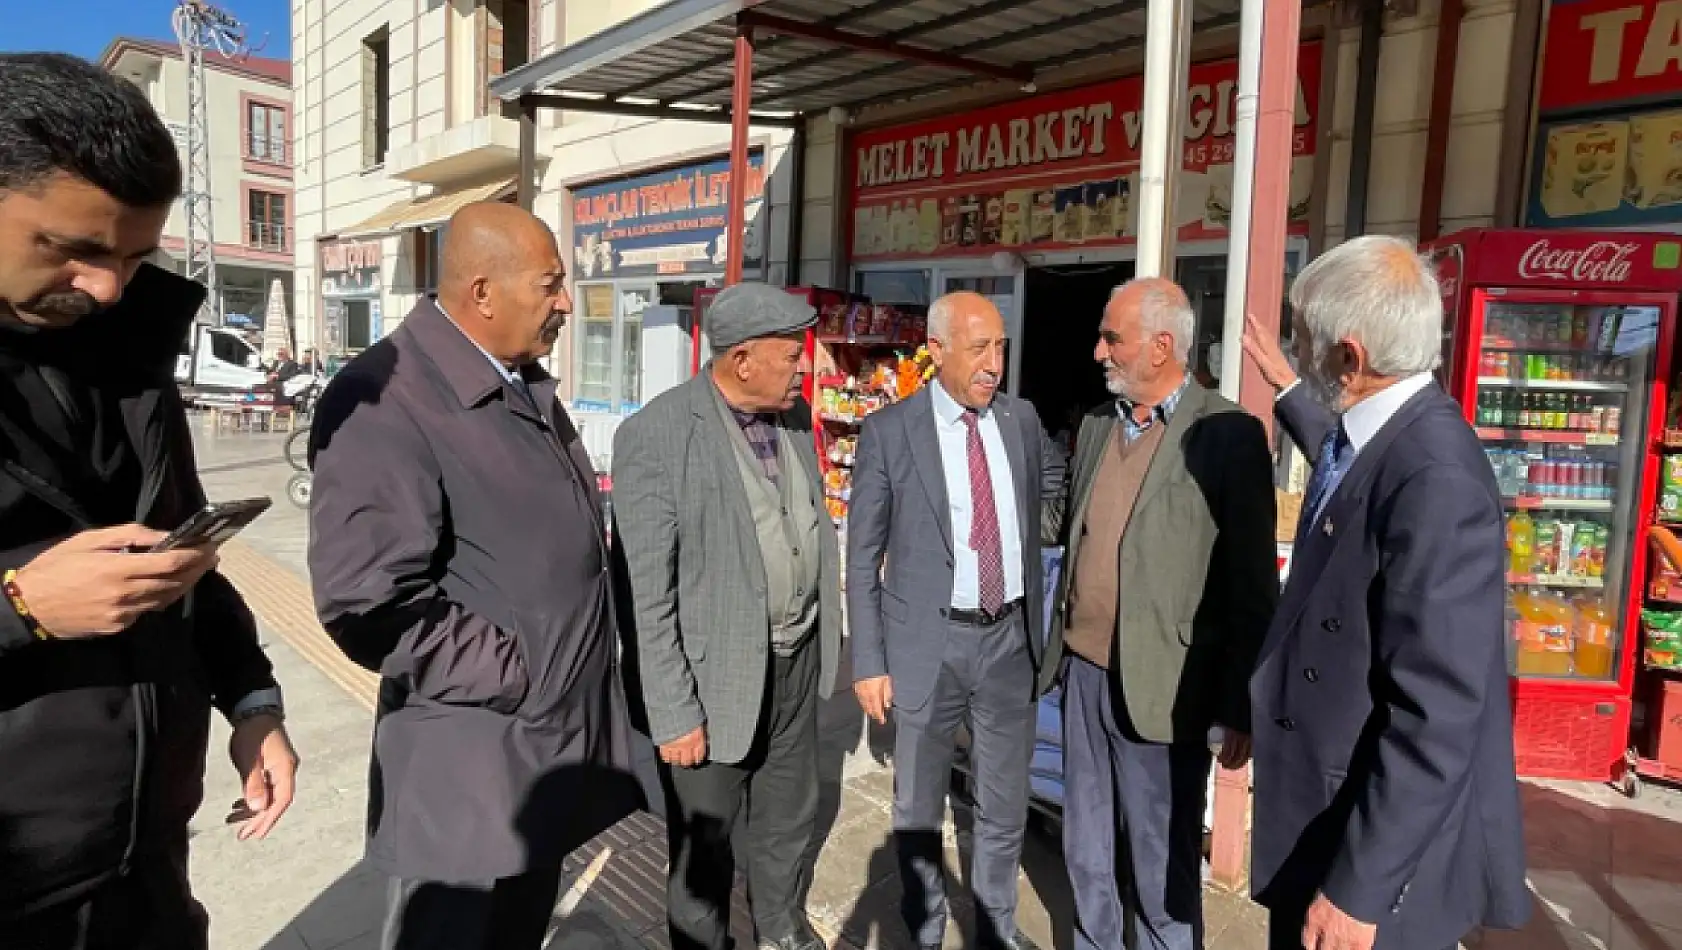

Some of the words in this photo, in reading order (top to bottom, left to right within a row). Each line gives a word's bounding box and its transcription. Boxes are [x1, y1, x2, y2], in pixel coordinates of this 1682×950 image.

[857, 132, 950, 187] MELET
[956, 102, 1112, 173] MARKET
[1122, 109, 1143, 149] v
[1184, 77, 1311, 140] GIA
